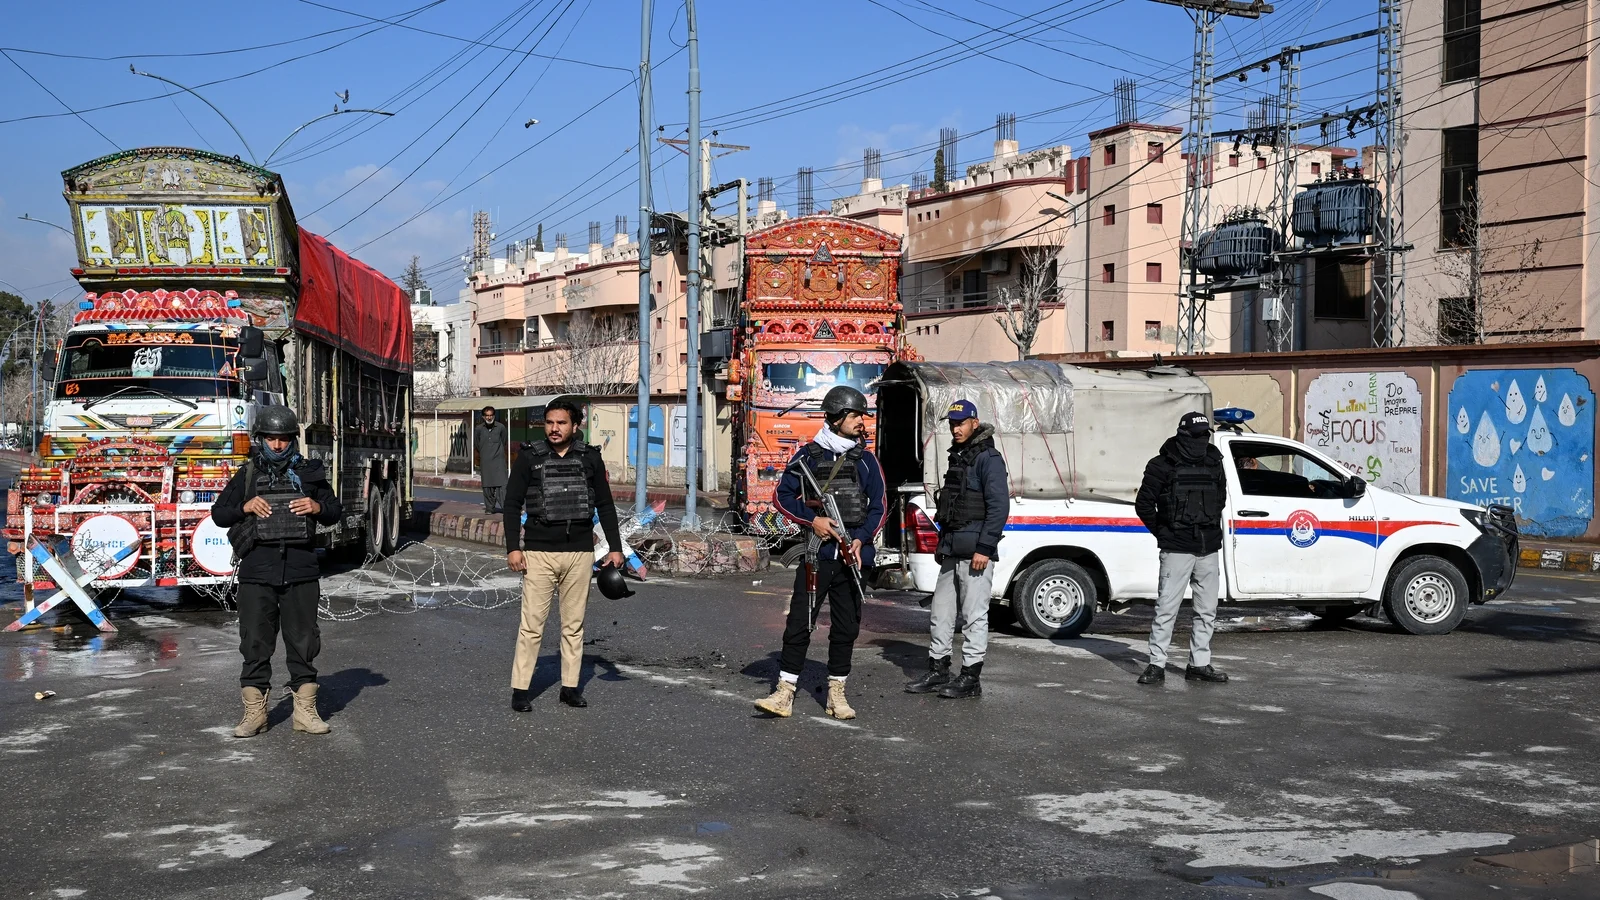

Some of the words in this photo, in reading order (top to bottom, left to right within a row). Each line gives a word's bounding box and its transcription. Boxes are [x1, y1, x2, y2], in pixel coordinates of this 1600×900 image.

[1368, 372, 1378, 414] LEARN
[1385, 382, 1403, 398] Do
[1384, 406, 1418, 417] PREPARE
[1317, 408, 1332, 447] Reach
[1331, 418, 1387, 444] FOCUS
[1460, 475, 1498, 494] SAVE
